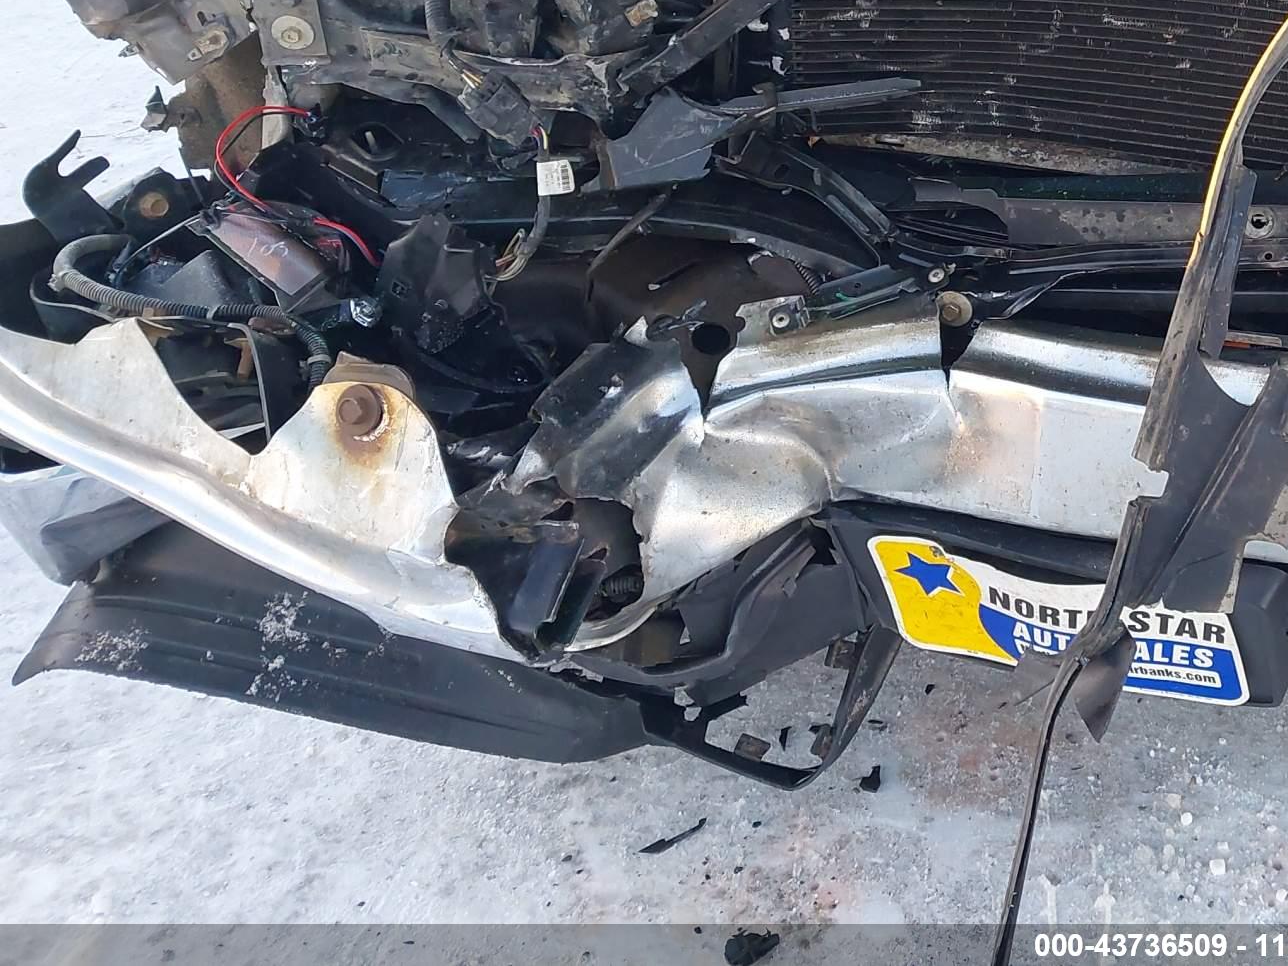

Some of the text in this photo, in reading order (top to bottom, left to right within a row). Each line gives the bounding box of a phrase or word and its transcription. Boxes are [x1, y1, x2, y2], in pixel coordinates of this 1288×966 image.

[989, 585, 1226, 644] NORT STAR
[1012, 621, 1071, 652] AUT
[1133, 641, 1214, 668] ALES
